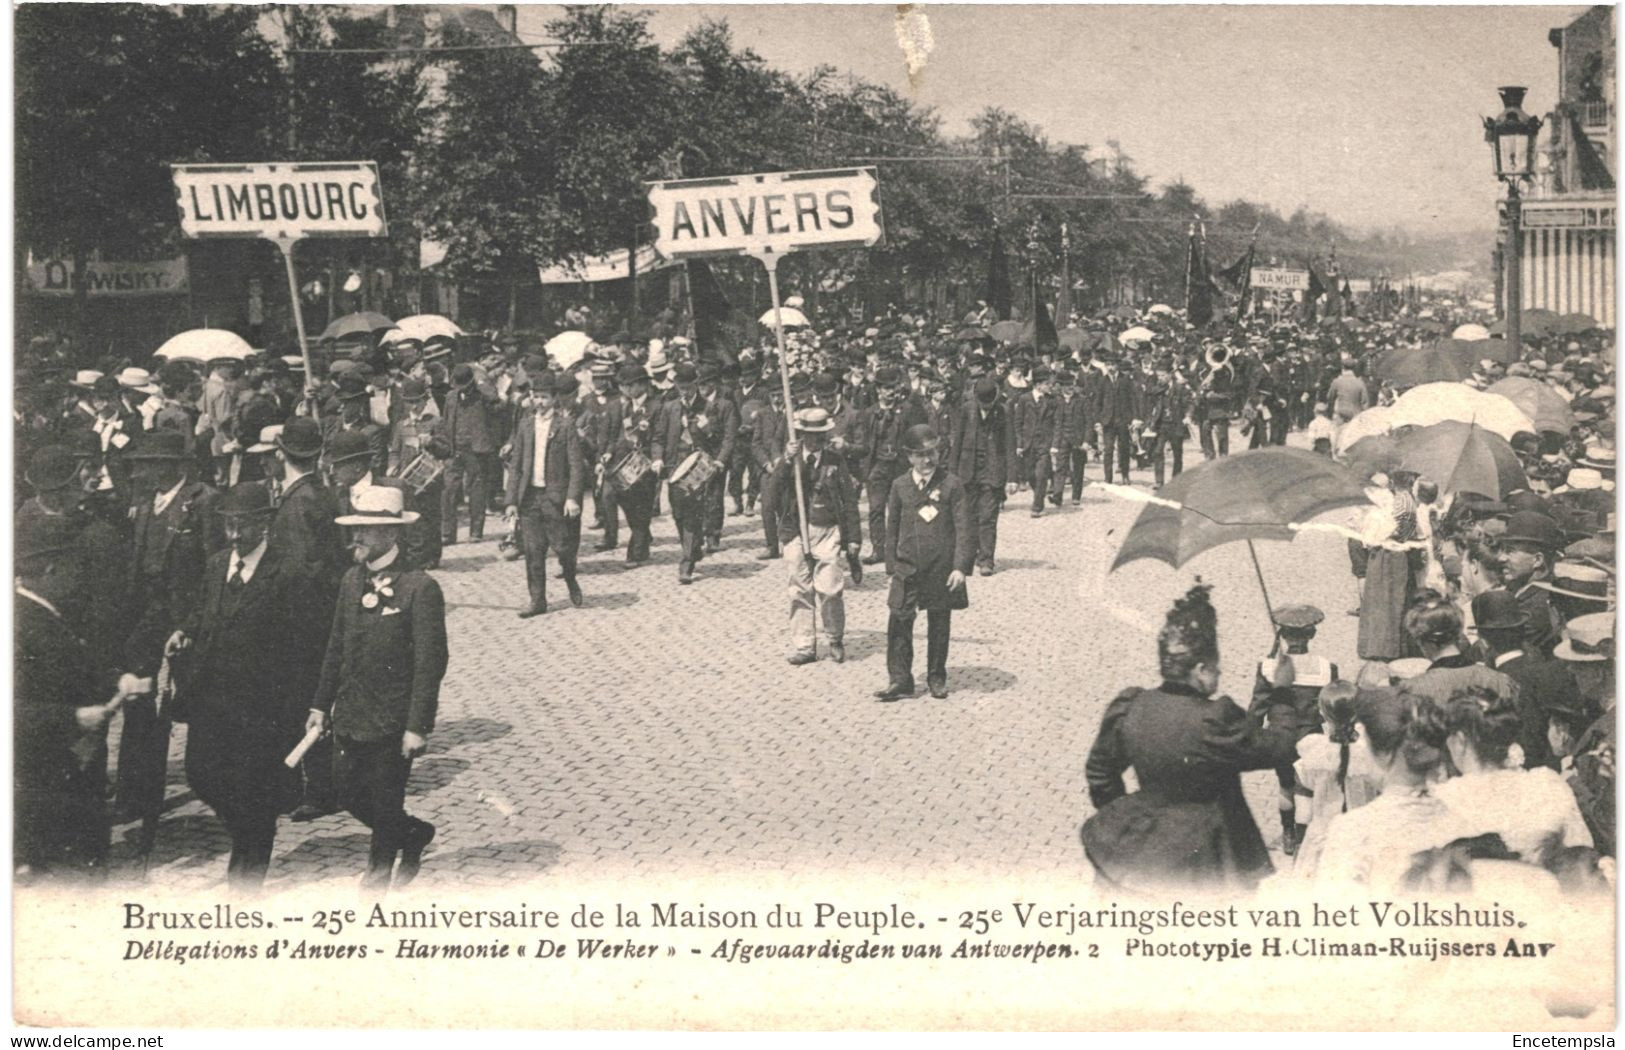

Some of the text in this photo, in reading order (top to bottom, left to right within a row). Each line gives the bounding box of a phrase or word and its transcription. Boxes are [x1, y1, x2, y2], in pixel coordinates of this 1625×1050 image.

[190, 182, 368, 221] LIMBOURG
[672, 190, 854, 240] ANVERS
[1259, 273, 1300, 286] NAMUR
